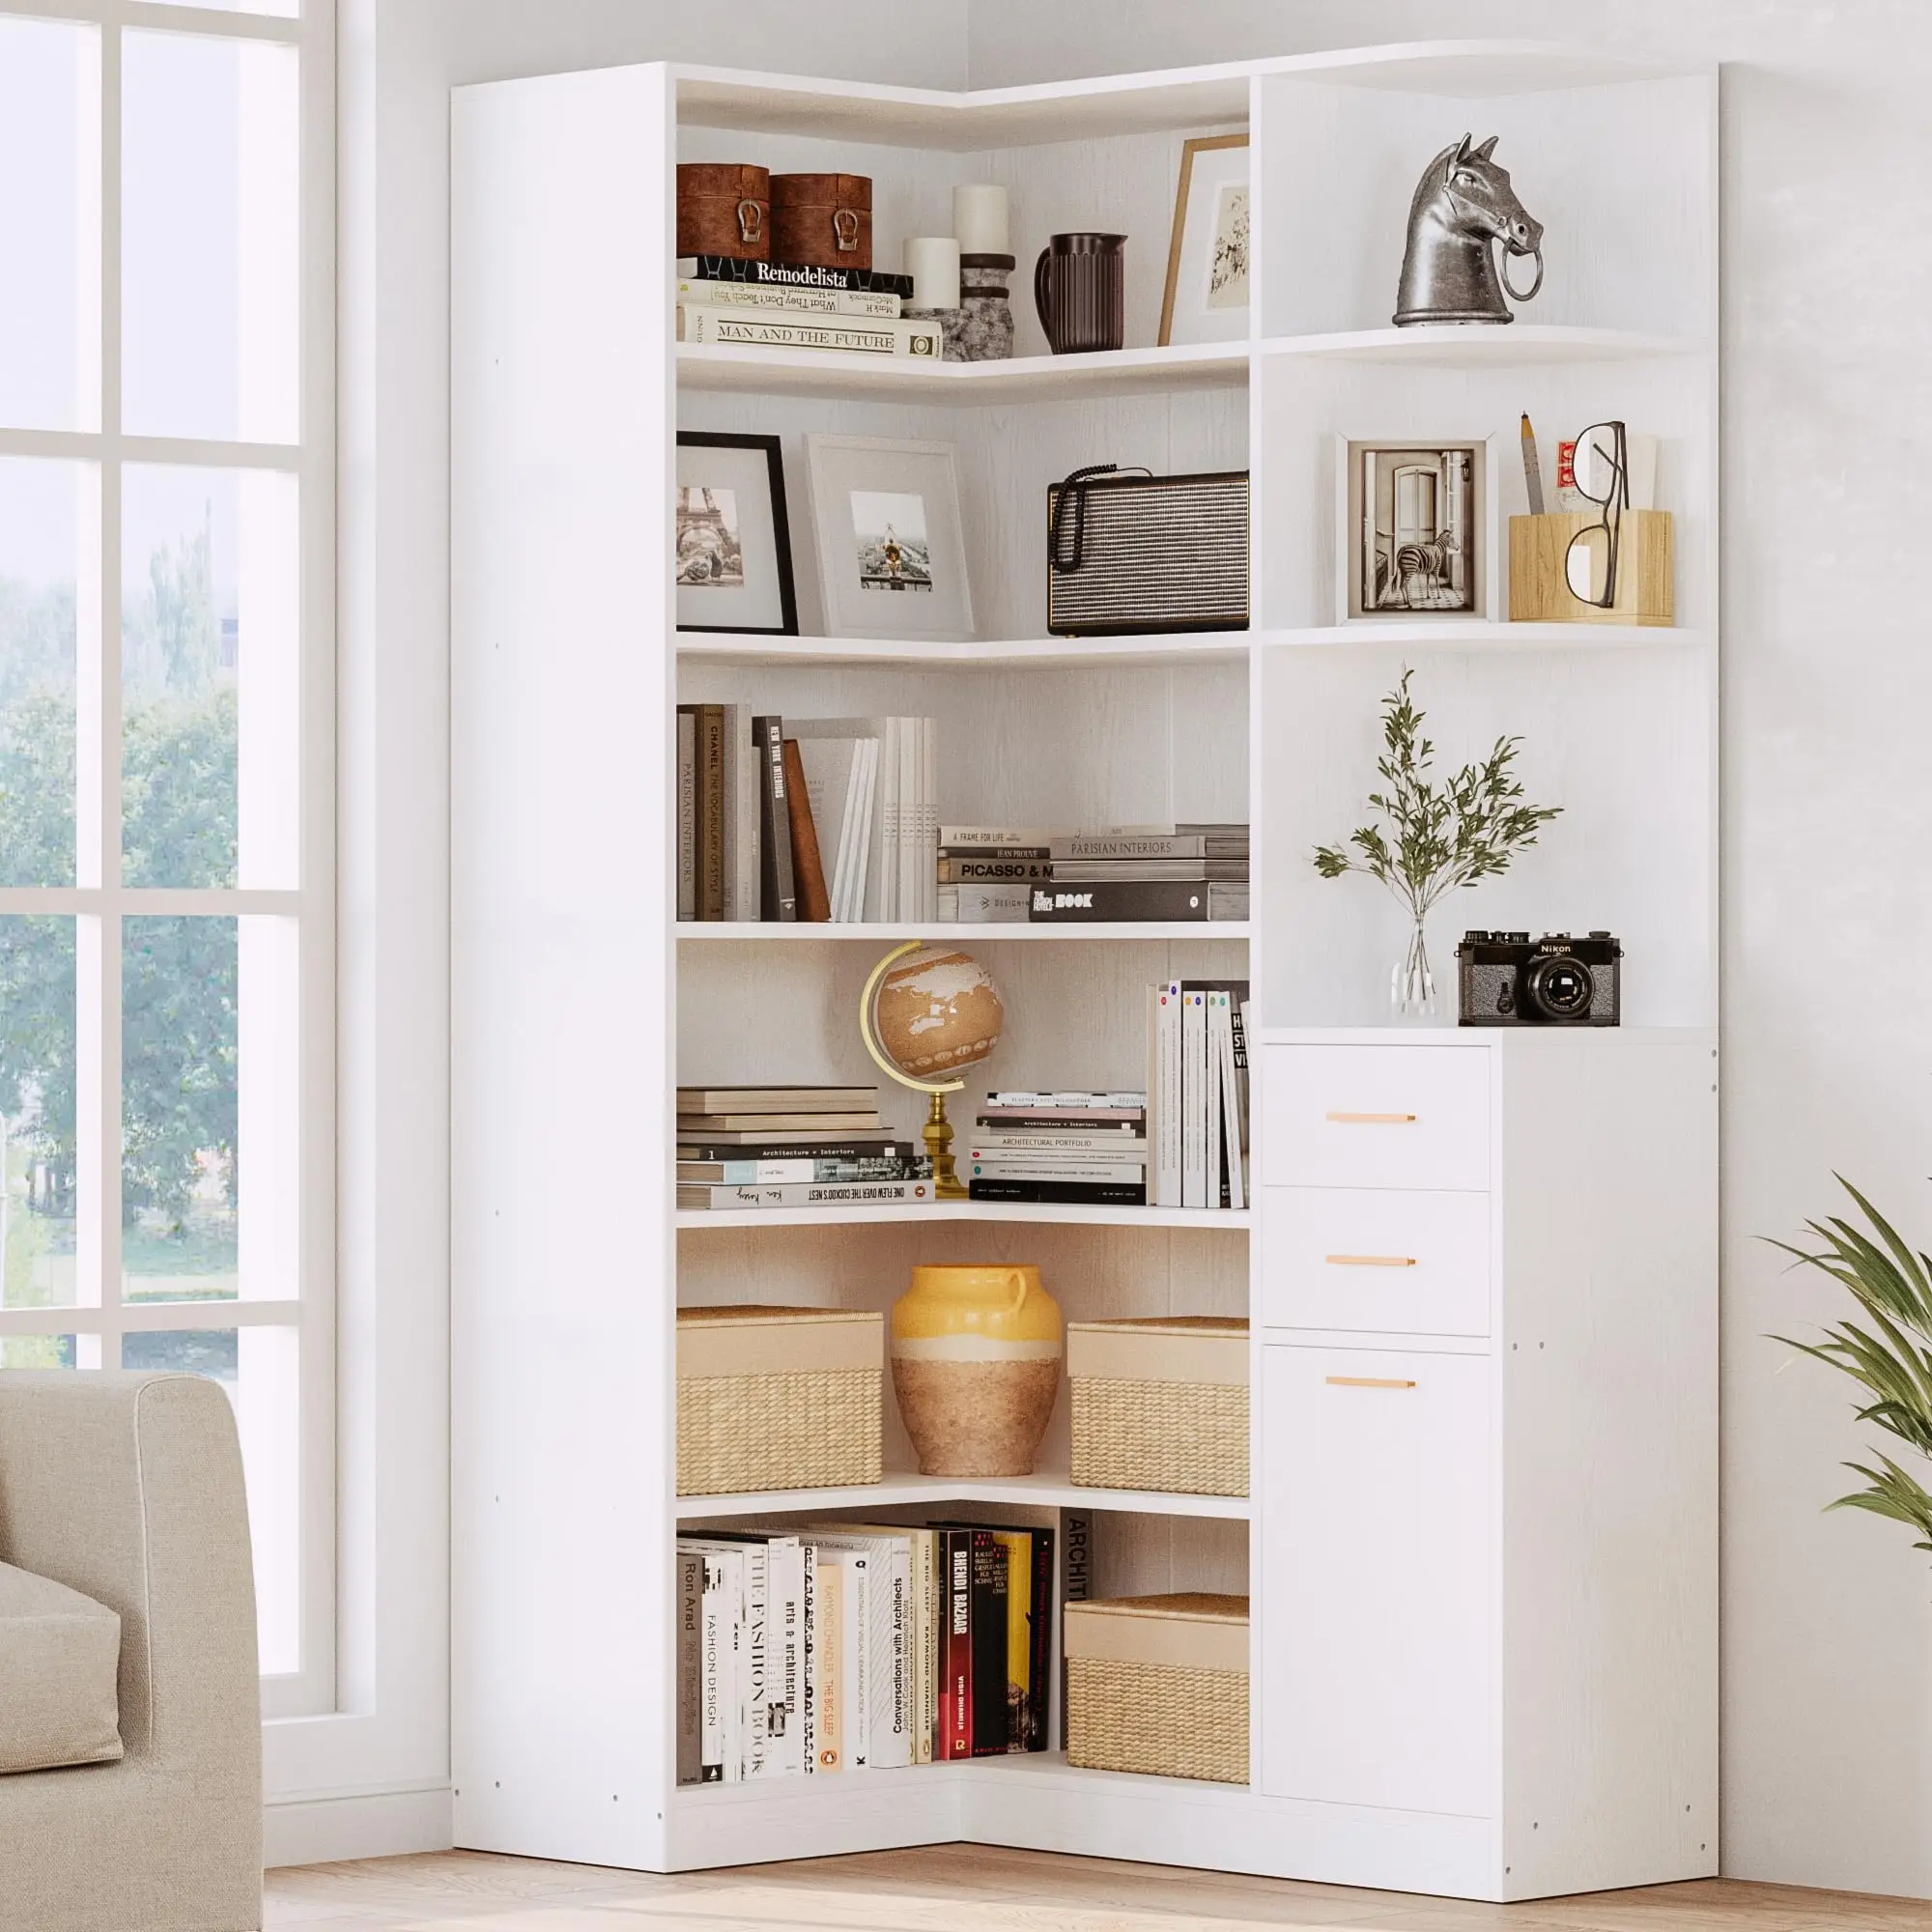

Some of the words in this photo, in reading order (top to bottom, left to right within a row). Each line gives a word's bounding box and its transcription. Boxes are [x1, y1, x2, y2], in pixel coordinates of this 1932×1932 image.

[757, 262, 848, 288] Remodelista
[714, 292, 731, 302] You
[732, 292, 759, 305] Teach
[759, 296, 784, 307] Don't
[785, 296, 810, 309] They
[810, 299, 836, 311] What
[719, 325, 753, 339] MAN
[759, 328, 792, 341] AND
[798, 330, 829, 344] THE
[835, 333, 895, 349] FUTURE
[770, 725, 779, 742] NEW
[710, 726, 719, 770] CHANEL
[771, 745, 781, 761] YORK
[682, 763, 692, 817] PARISIAN
[710, 773, 719, 790] THE
[773, 765, 784, 799] INTERIORS
[710, 792, 719, 852] VOCABULARY
[960, 833, 979, 842] FRAME
[980, 833, 991, 842] FOR
[993, 833, 1005, 842] LIFE
[1071, 841, 1117, 855] PARISIAN
[1120, 841, 1172, 854] INTERIORS
[682, 822, 692, 883] INTERIORS
[710, 854, 719, 866] OF
[710, 867, 719, 894] STYLE
[962, 865, 1026, 877] PICASSO
[1029, 866, 1039, 877] &
[1055, 894, 1094, 908] BOOK
[709, 1151, 715, 1159] 1
[809, 1189, 822, 1200] NEST
[823, 1188, 850, 1200] CUCKOO'S
[851, 1188, 862, 1200] THE
[863, 1188, 877, 1200] OVER
[877, 1188, 893, 1200] FLEW
[895, 1187, 904, 1200] ONE
[686, 1563, 696, 1592] Ron
[752, 1548, 765, 1598] THE
[954, 1551, 967, 1590] BHENDI
[686, 1597, 696, 1631] Arad
[785, 1602, 796, 1624] arts
[824, 1585, 835, 1628] RAYMOND
[893, 1577, 902, 1631] Architects
[954, 1594, 967, 1634] BAZAAR
[707, 1615, 717, 1673] FASHION
[752, 1604, 765, 1702] FASHION
[824, 1631, 835, 1673] CHANDLER
[893, 1634, 902, 1656] with
[785, 1643, 797, 1714] architecture
[824, 1681, 835, 1696] THE
[707, 1678, 717, 1726] DESIGN
[824, 1698, 835, 1712] BIG
[893, 1658, 902, 1733] Conversations
[824, 1714, 835, 1737] SLEEP
[751, 1709, 766, 1774] BOOK
